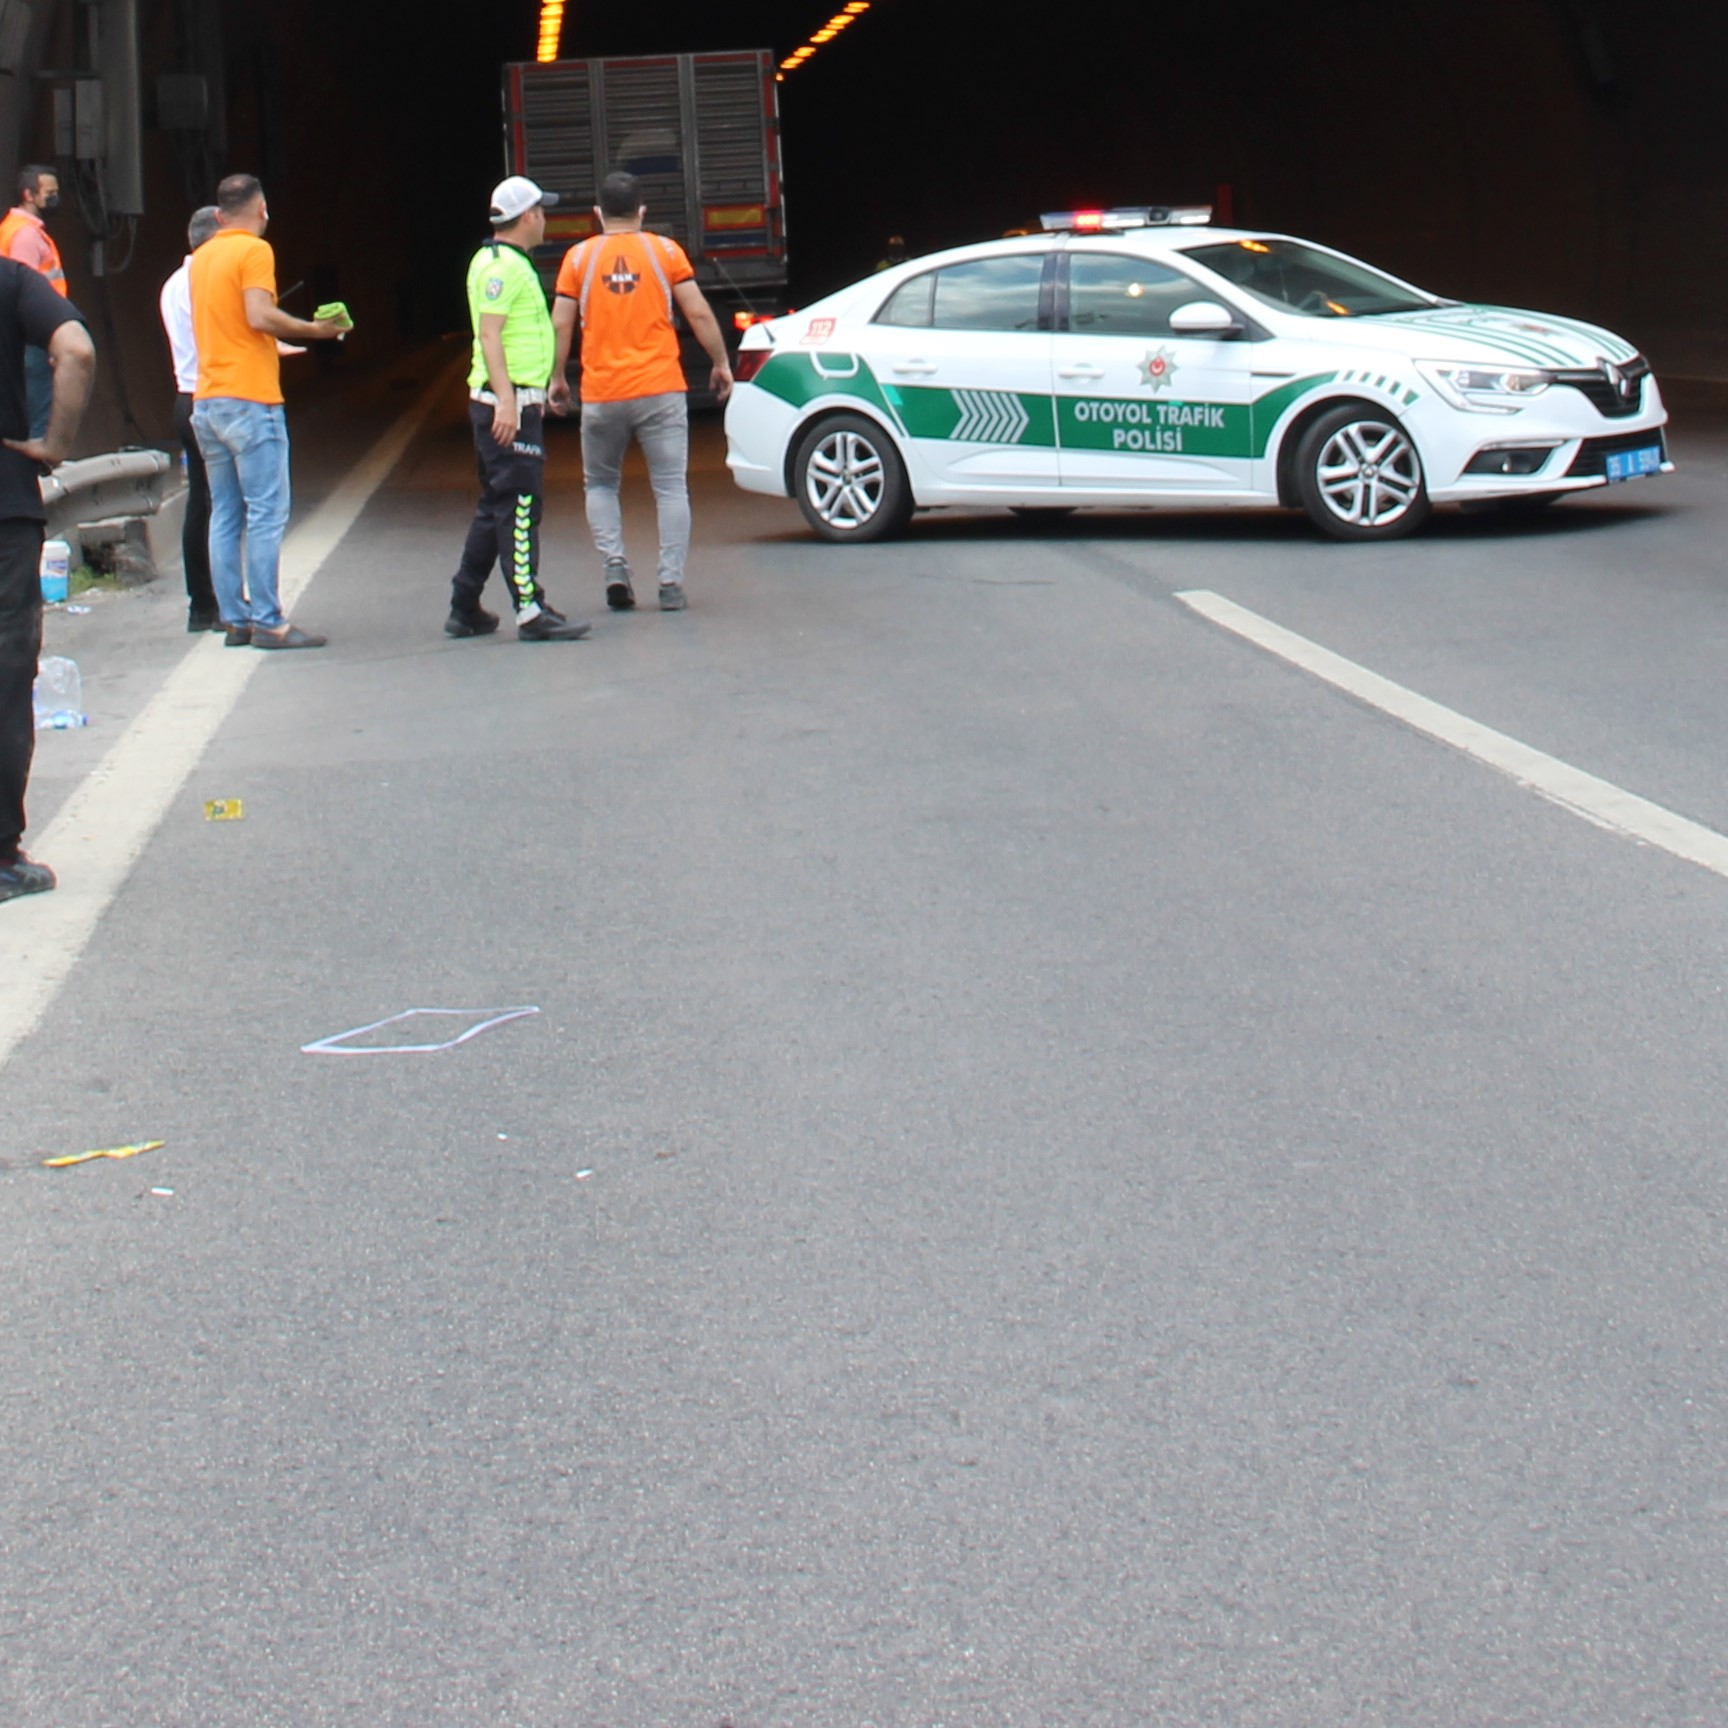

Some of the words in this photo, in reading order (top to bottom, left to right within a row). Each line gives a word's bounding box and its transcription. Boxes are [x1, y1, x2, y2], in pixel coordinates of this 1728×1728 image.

[1074, 401, 1152, 424] OTOYOL
[1156, 402, 1225, 428] TRAFİK
[1113, 425, 1183, 452] POLİSİ
